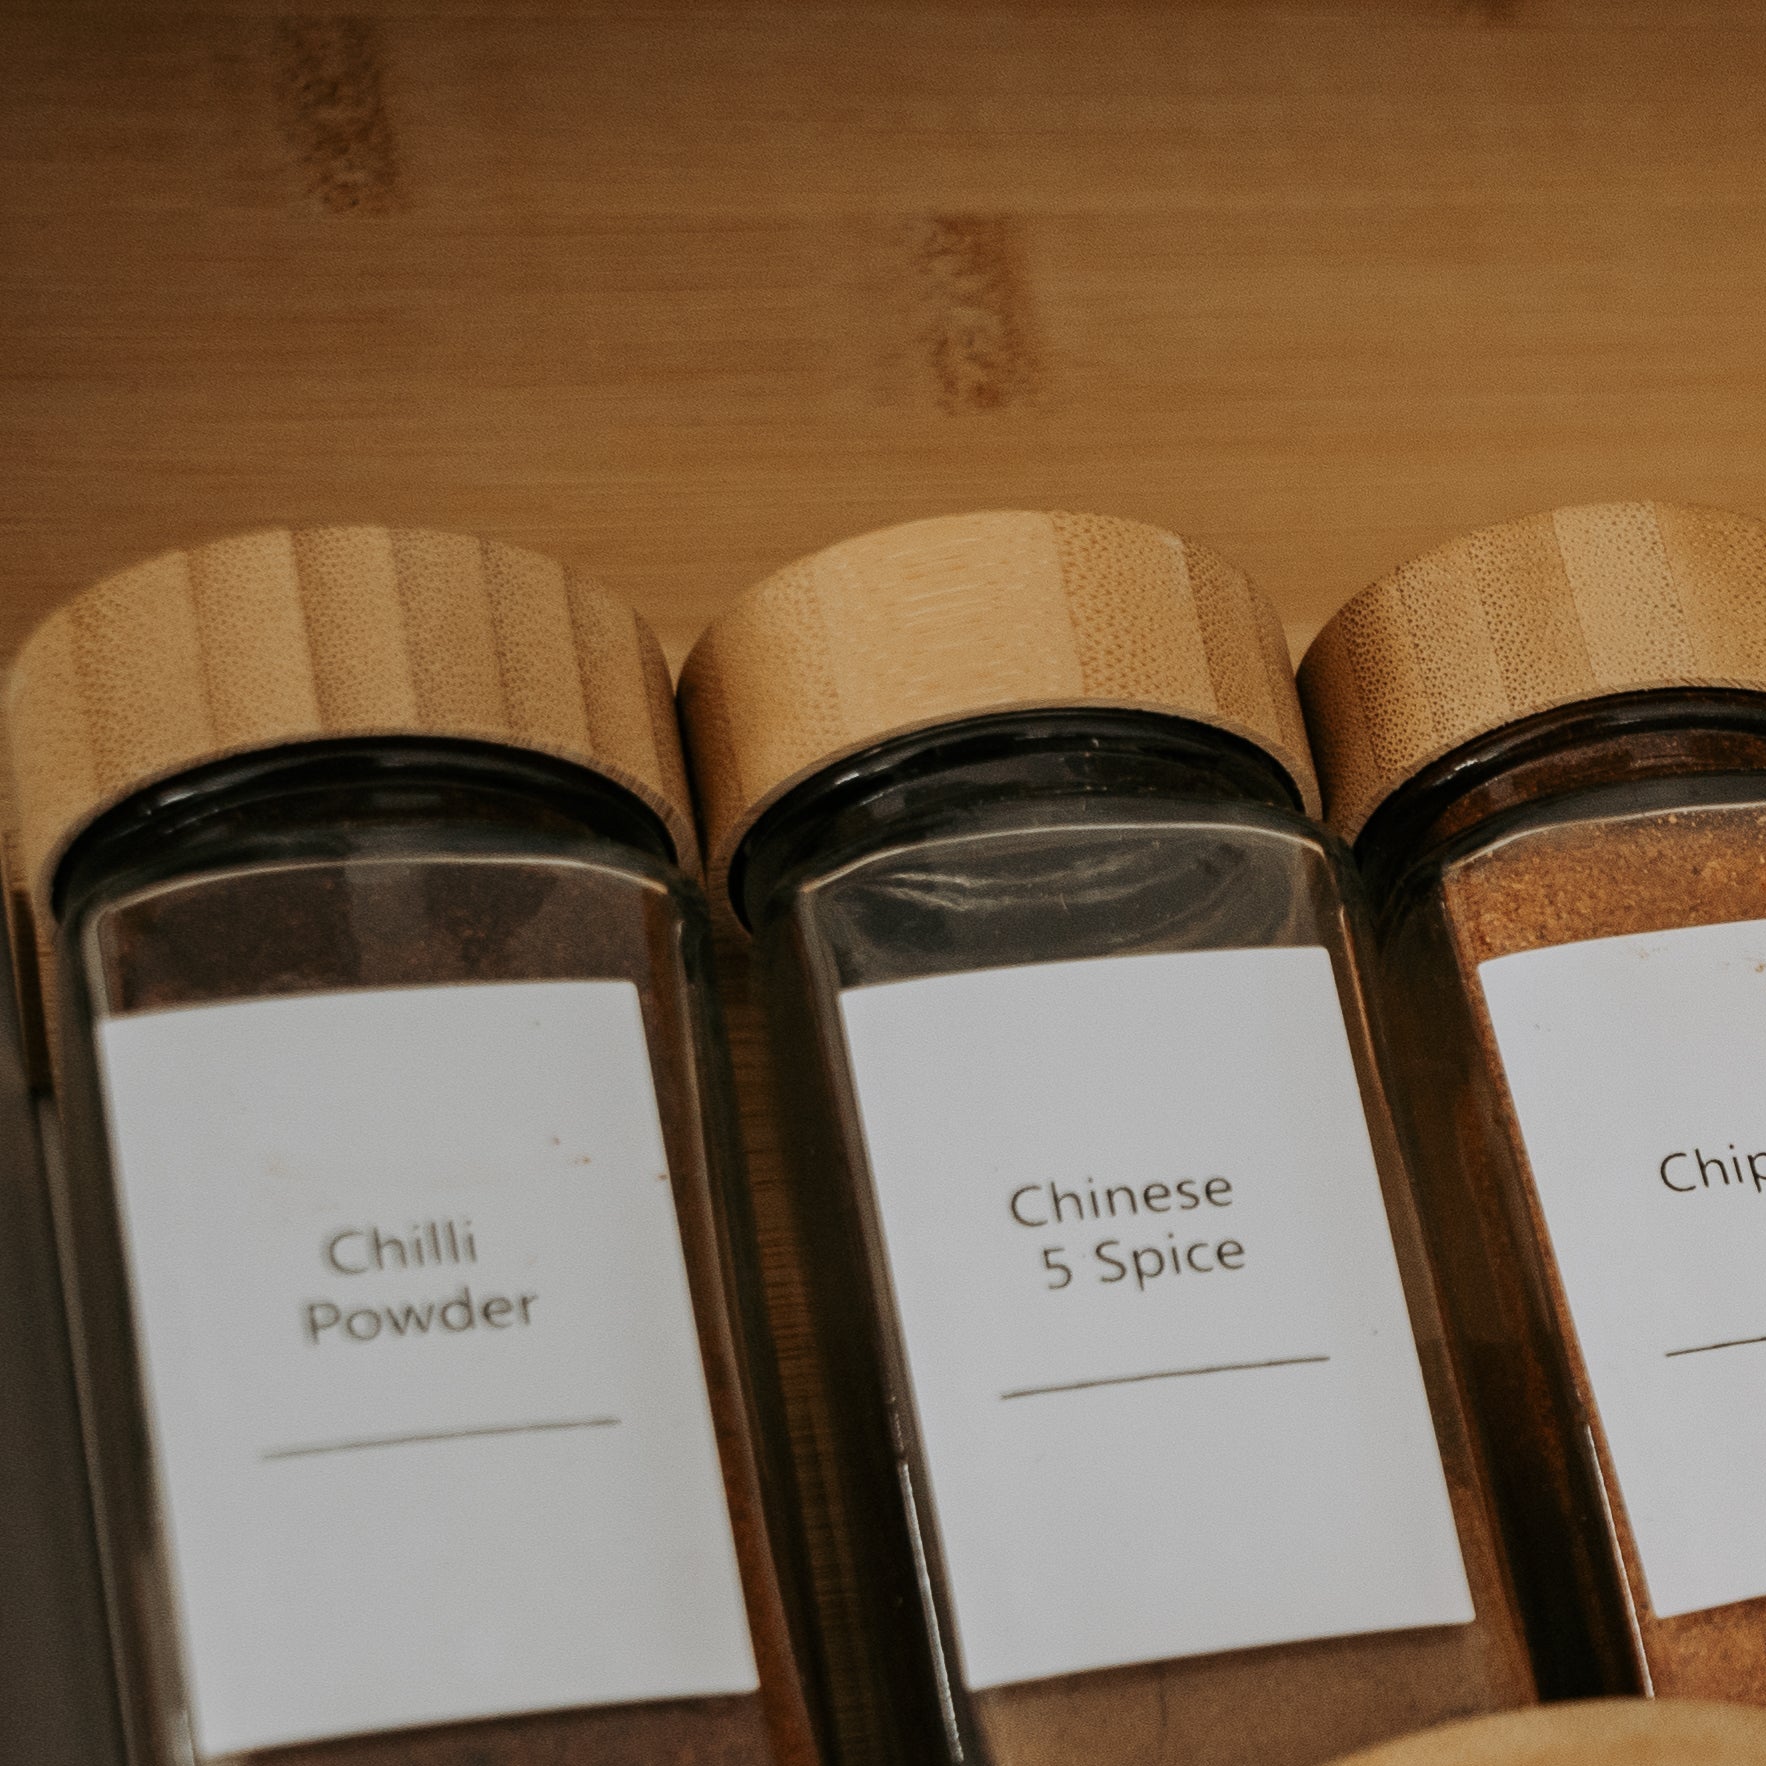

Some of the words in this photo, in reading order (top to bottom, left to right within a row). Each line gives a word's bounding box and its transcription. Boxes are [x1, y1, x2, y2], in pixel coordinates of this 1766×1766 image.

[1009, 1175, 1232, 1228] Chinese
[322, 1219, 478, 1276] Chilli
[1042, 1247, 1072, 1290] 5
[1094, 1237, 1245, 1291] Spice
[303, 1286, 538, 1346] Powder
